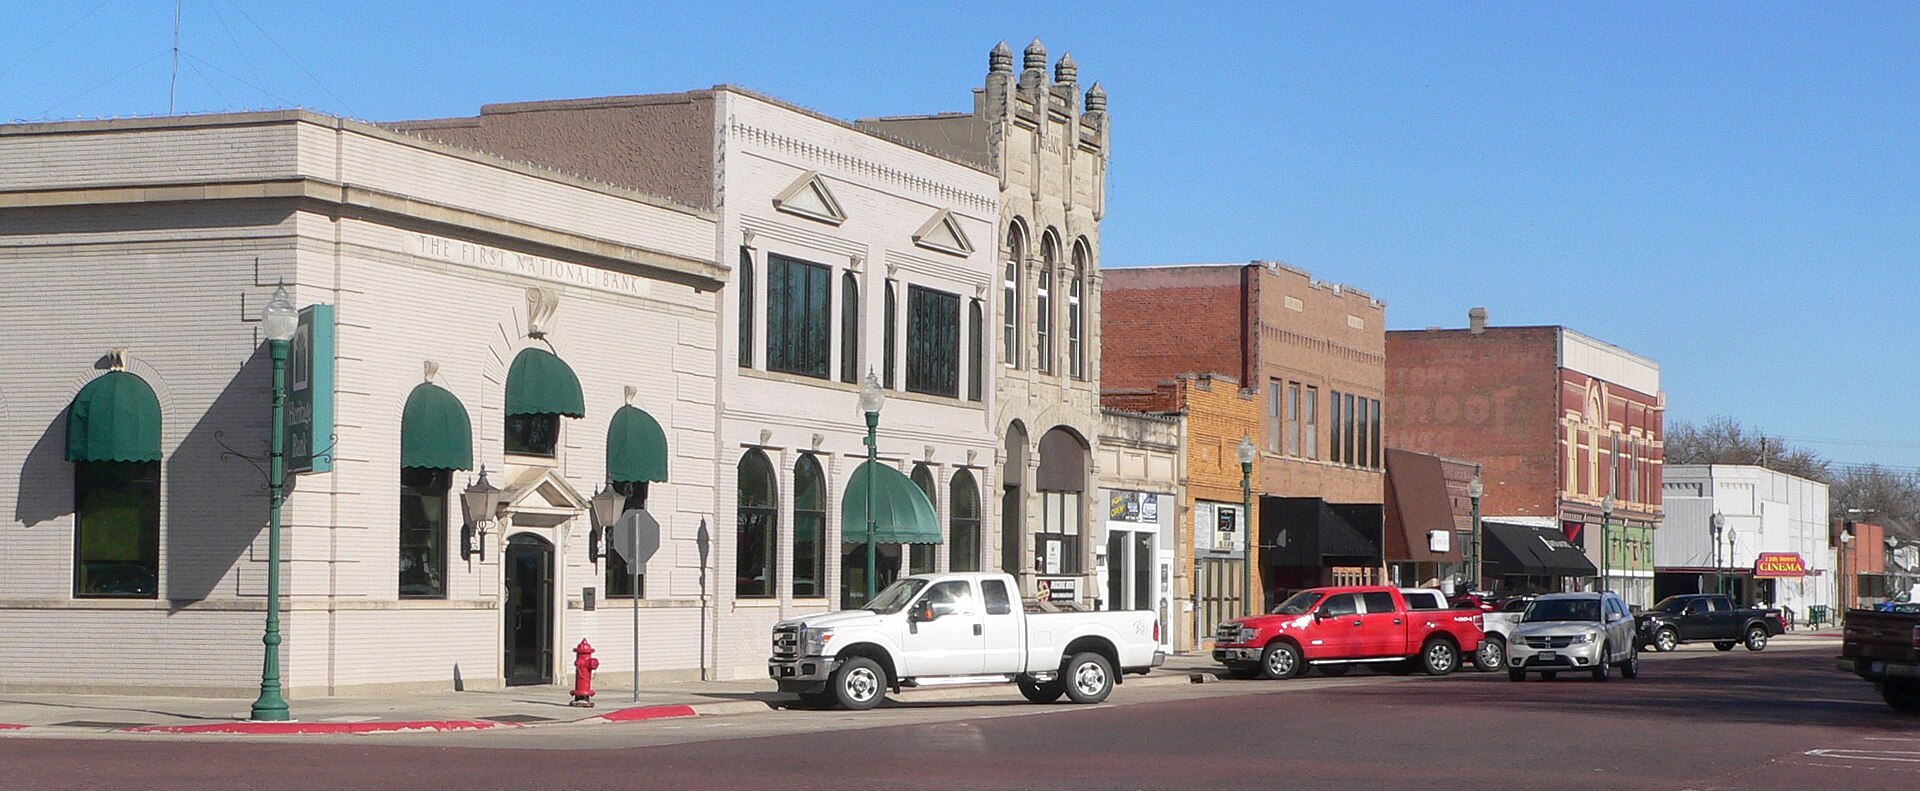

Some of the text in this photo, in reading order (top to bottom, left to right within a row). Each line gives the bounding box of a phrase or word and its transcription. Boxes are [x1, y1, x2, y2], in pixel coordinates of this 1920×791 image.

[419, 235, 638, 293] THE FIRST NATIONAL BANK
[1759, 562, 1803, 572] CINEMA
